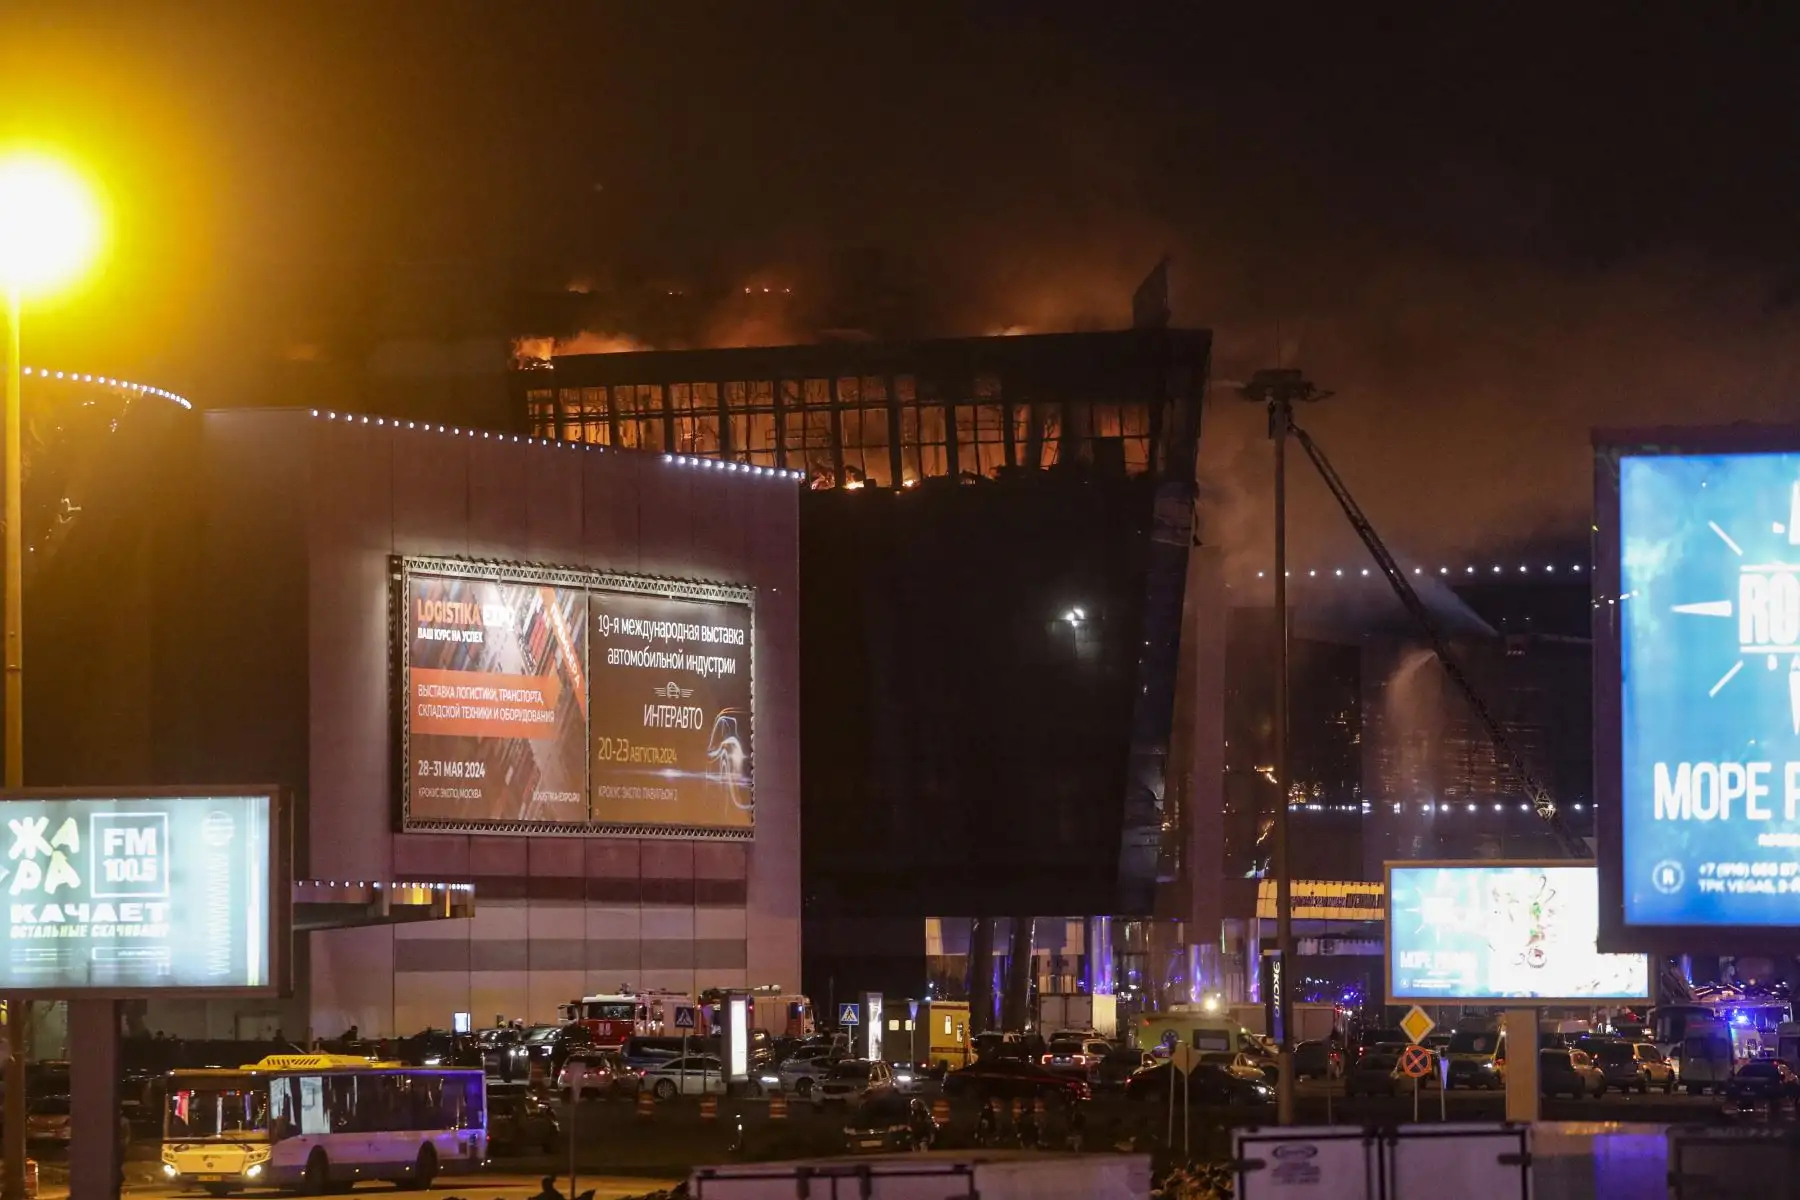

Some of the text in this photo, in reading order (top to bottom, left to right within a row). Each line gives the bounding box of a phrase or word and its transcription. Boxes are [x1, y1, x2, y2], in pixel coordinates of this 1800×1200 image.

[417, 599, 482, 625] LOGISTIKA
[418, 627, 483, 643] ВАШ КУРС НА УСПЕХ
[598, 614, 744, 645] 19-я международная выставка
[607, 645, 736, 678] автомобильной индустрии
[418, 684, 455, 698] ВЫСТАВКА
[418, 703, 555, 723] СКЛАДСКОЙ ТЕХНИКИ И ОБОРУДОВАНИЯ
[643, 704, 703, 730] ИНТЕРАВТО
[598, 737, 629, 762] 20-23
[630, 746, 659, 763] АВГУСТА
[418, 759, 486, 778] 28-31 МАЯ 2024
[1654, 762, 1772, 820] МОРЕ
[104, 828, 157, 856] FM
[103, 858, 157, 883] 100.5
[10, 903, 170, 923] КАЧАЕТ
[10, 923, 88, 938] ОСТАЛЬНЫЕ
[1272, 961, 1281, 1018] ЭКСПО
